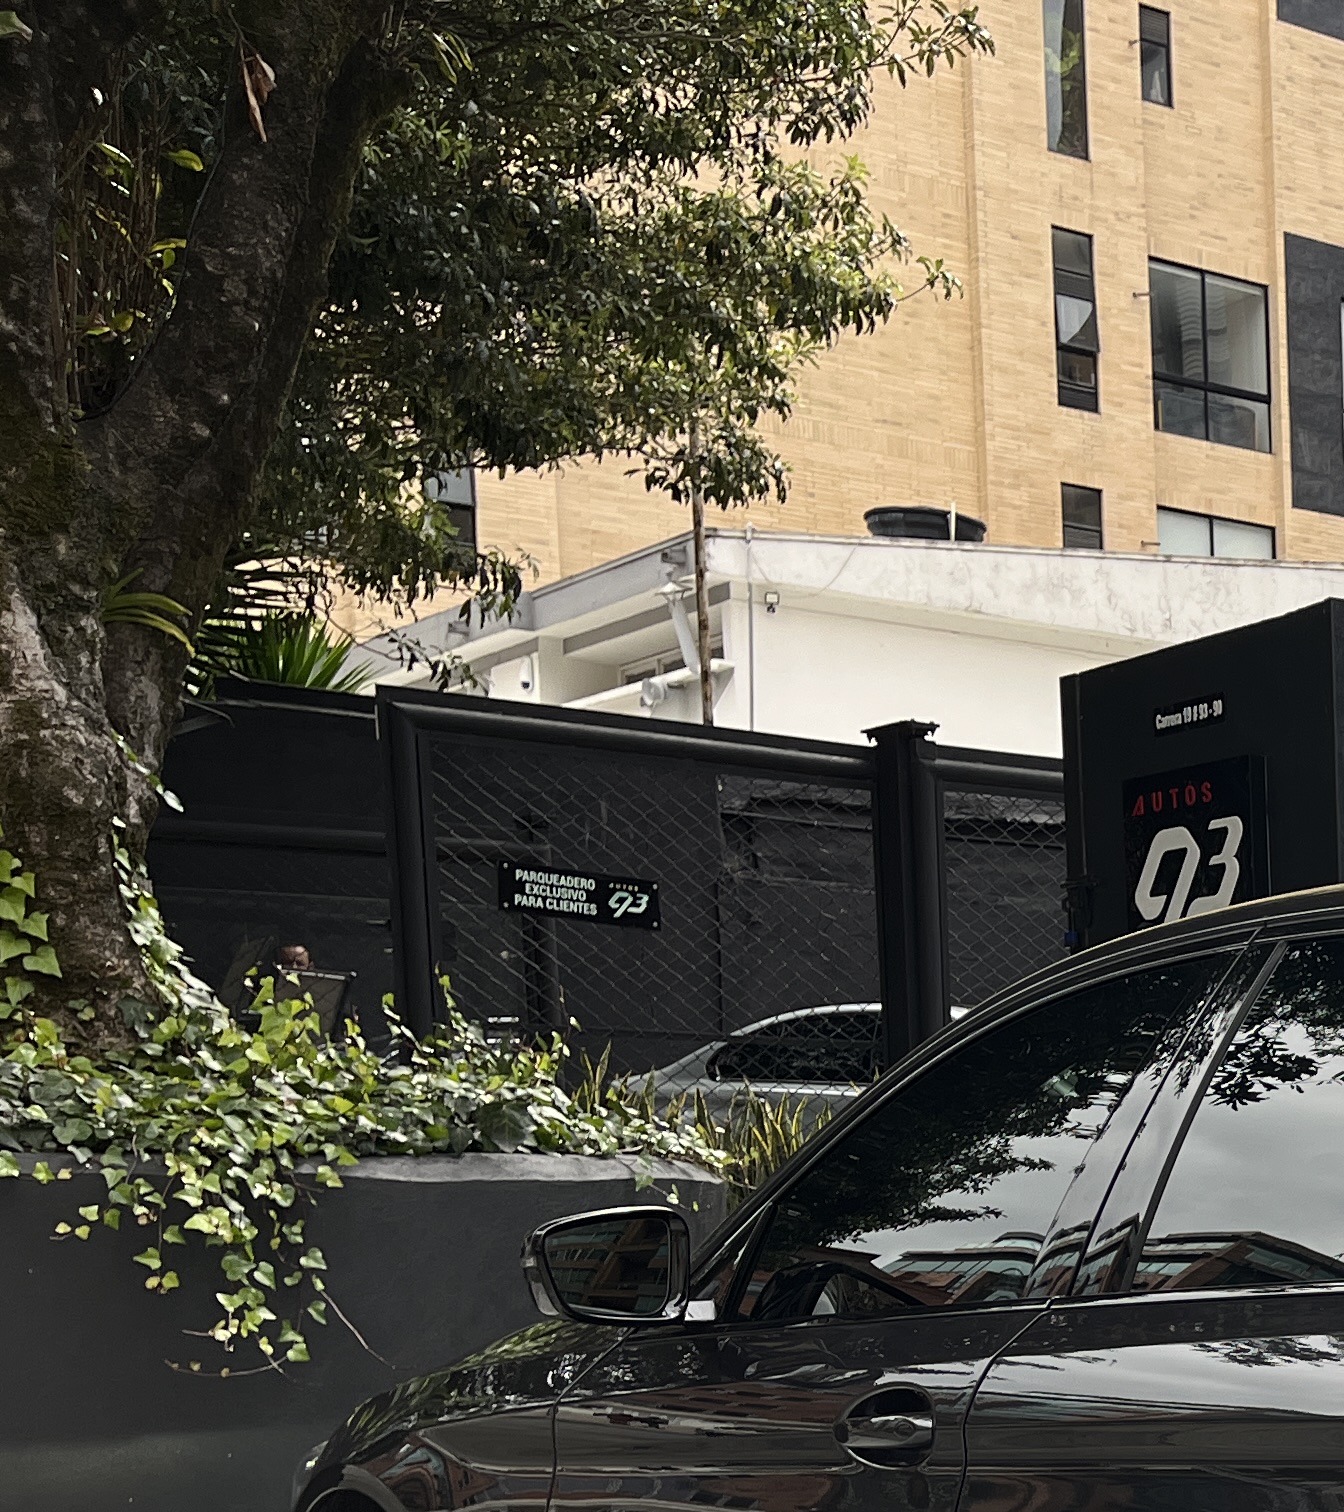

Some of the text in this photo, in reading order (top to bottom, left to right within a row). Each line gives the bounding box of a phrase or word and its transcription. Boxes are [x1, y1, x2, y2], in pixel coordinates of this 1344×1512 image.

[1132, 781, 1213, 817] AUTOS
[515, 868, 596, 891] PARQUEADERO
[1134, 815, 1244, 924] 93
[514, 893, 598, 916] PARA CLIENTES
[525, 882, 587, 902] EXCLUSIVO
[608, 891, 649, 918] 93
